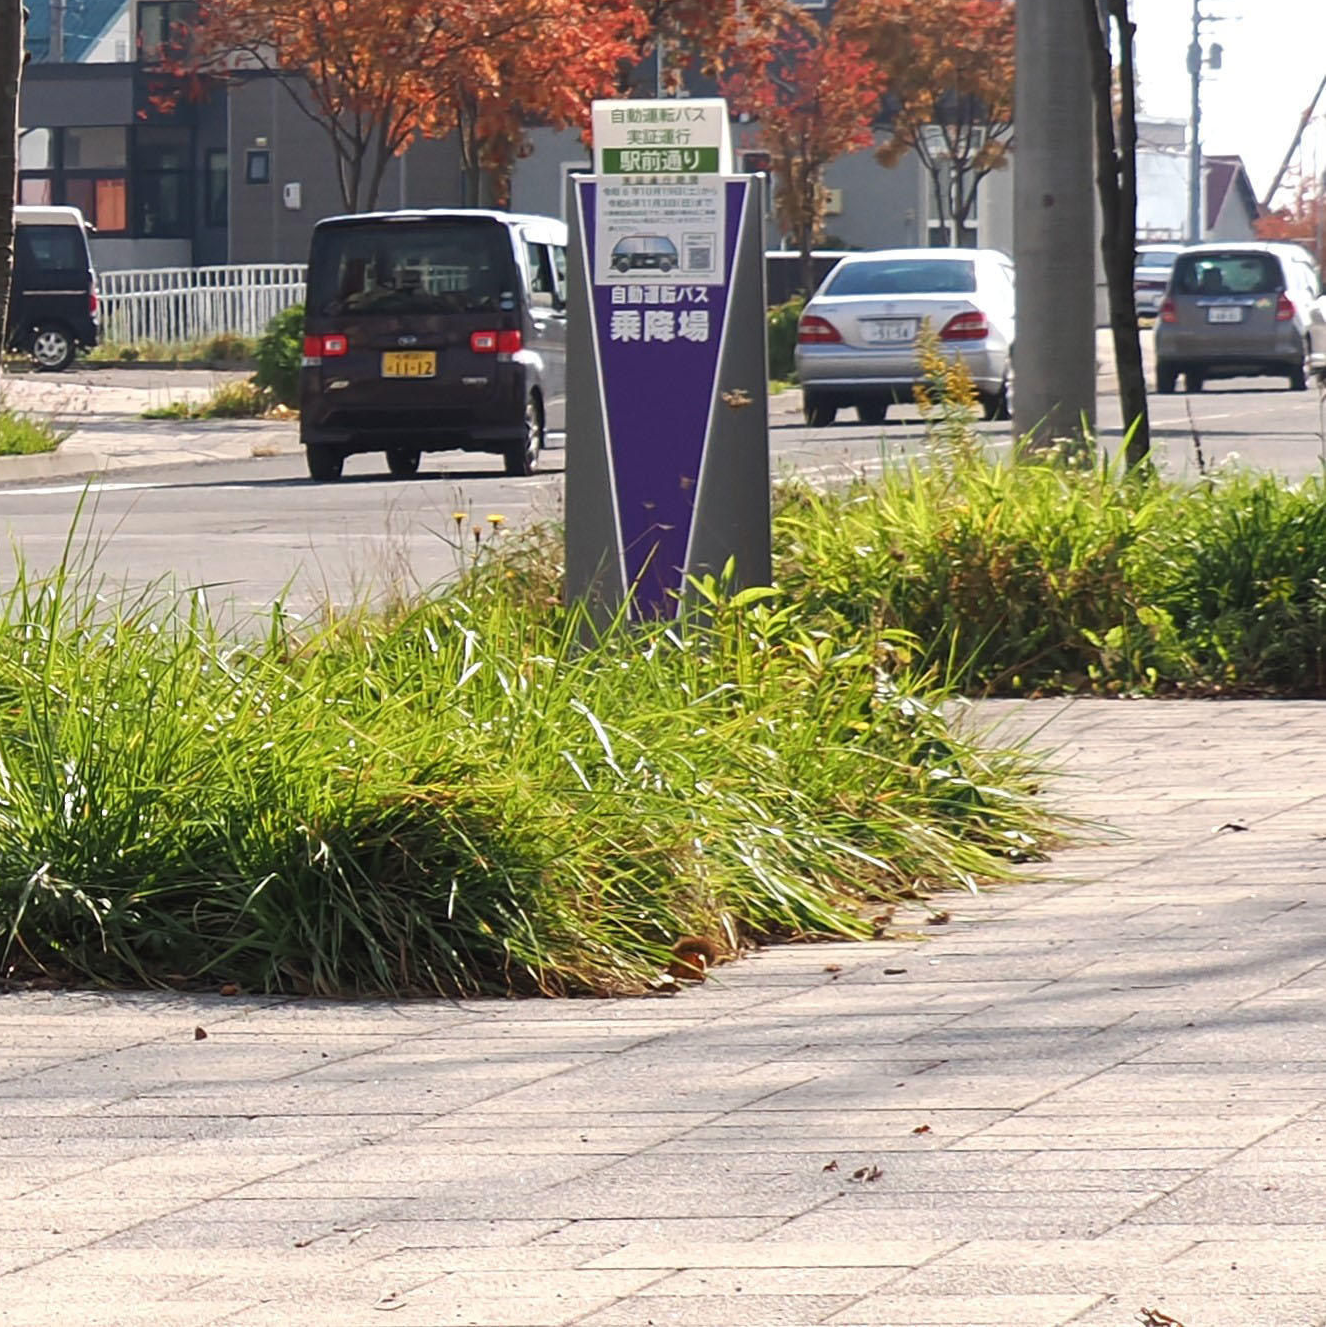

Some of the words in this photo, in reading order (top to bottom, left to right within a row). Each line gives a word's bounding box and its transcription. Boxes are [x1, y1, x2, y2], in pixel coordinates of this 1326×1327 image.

[611, 107, 707, 124] 自動運転バス
[627, 129, 692, 145] 実証運行
[619, 149, 700, 172] 駅前通り
[611, 285, 709, 304] 自動運転バス
[610, 310, 709, 342] 乗降場
